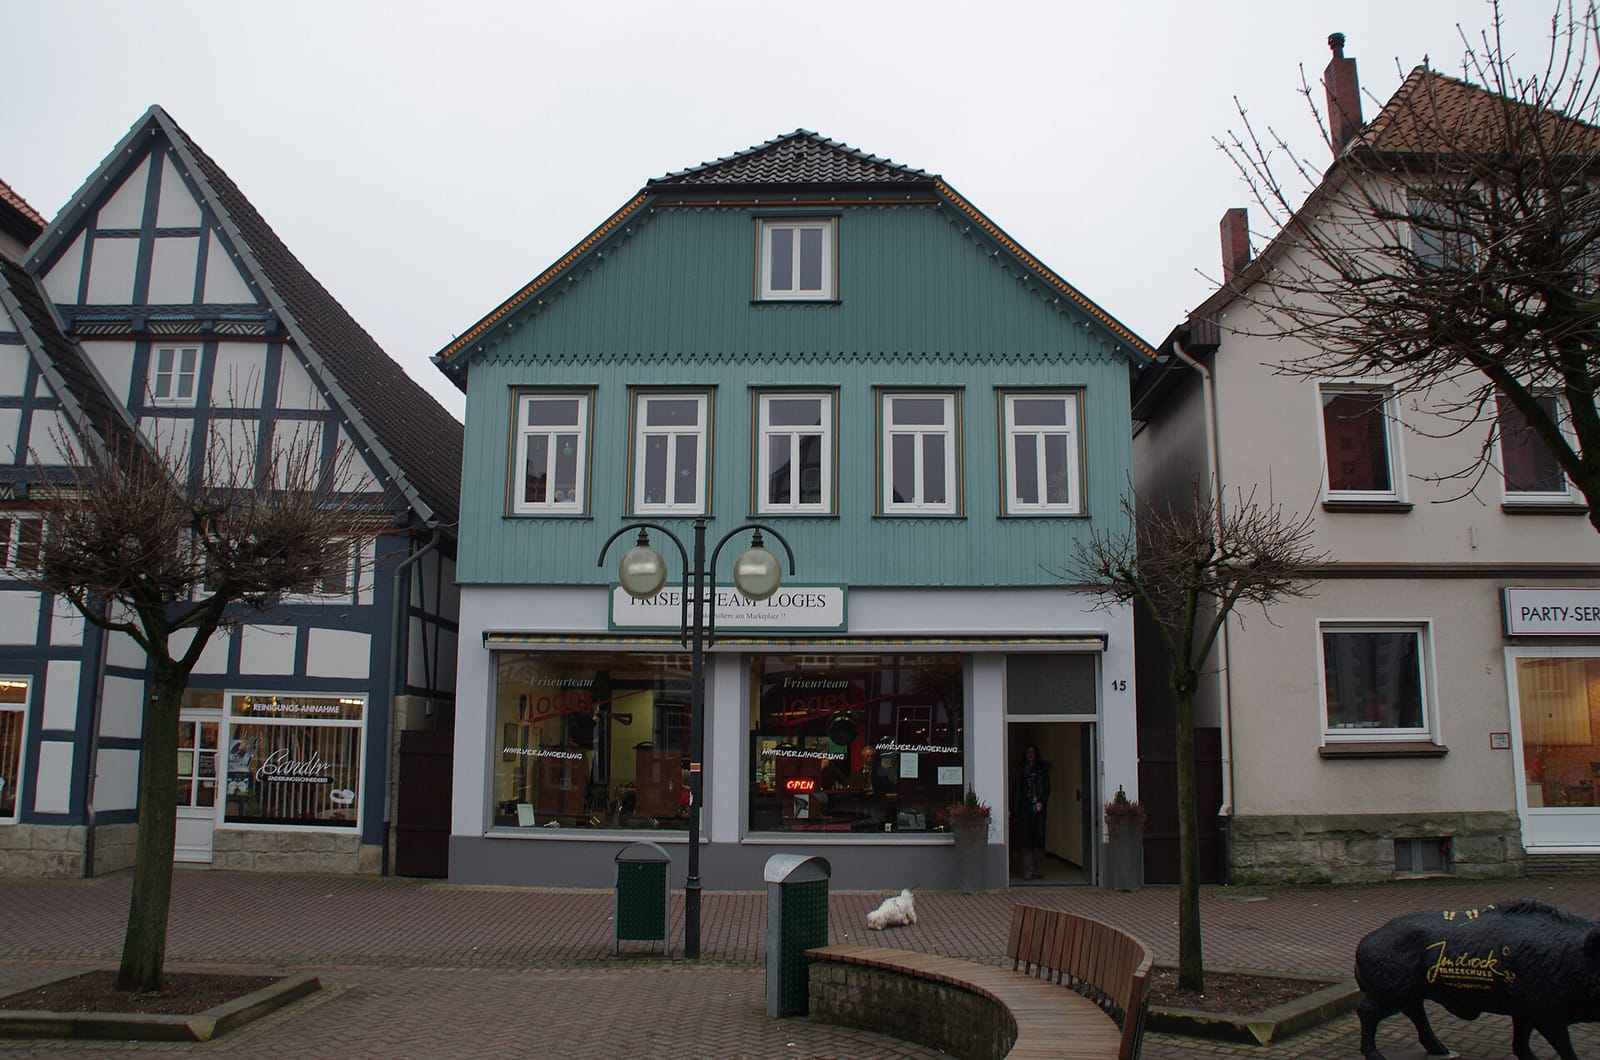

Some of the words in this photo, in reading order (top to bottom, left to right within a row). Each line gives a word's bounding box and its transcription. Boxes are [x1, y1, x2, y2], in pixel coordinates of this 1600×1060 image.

[767, 593, 826, 608] LOGES
[1520, 606, 1600, 622] PARTY-SER
[530, 675, 594, 688] Friseurteam
[783, 676, 849, 689] Friseurteam
[1111, 679, 1127, 692] 15
[253, 703, 340, 713] REINIGUNGS-ANNAHME
[785, 779, 815, 791] OPEN
